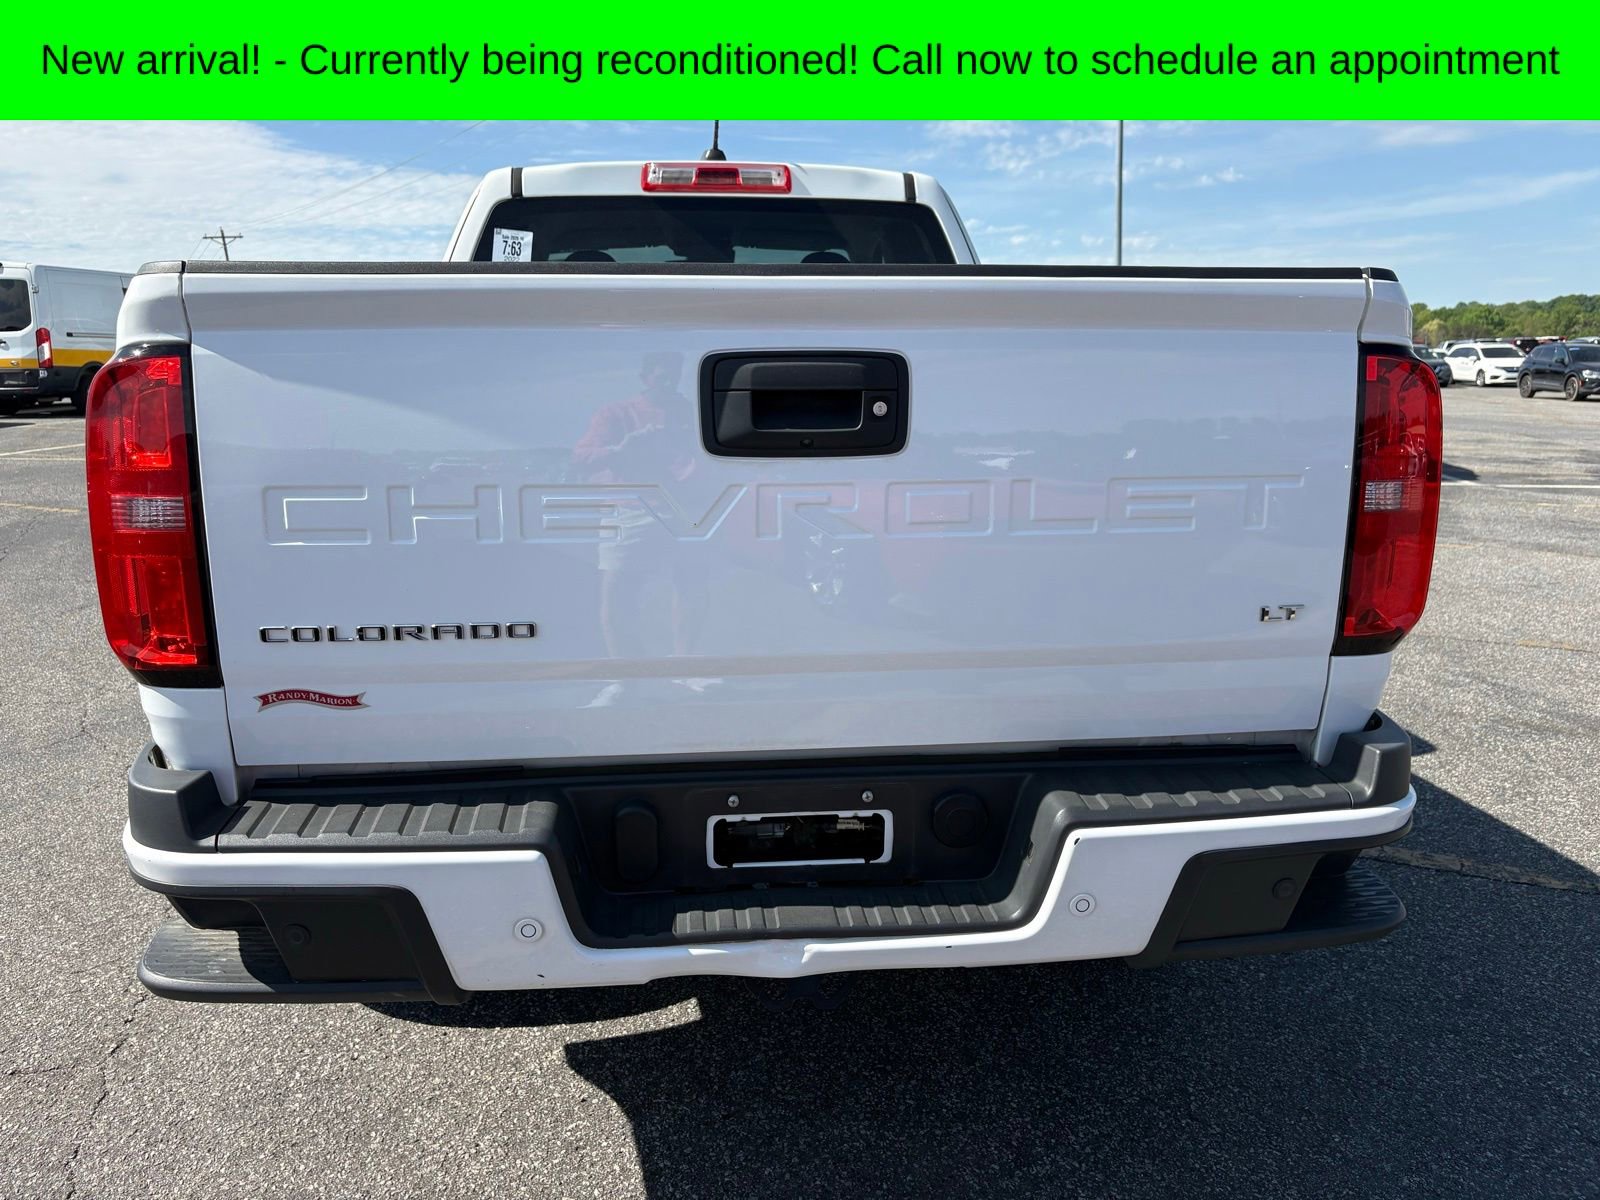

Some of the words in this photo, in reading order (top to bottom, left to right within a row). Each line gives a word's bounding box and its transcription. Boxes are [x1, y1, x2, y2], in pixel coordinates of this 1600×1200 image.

[262, 475, 1304, 545] CHEVROLET
[1260, 604, 1304, 622] LT
[259, 621, 537, 643] COLORADO
